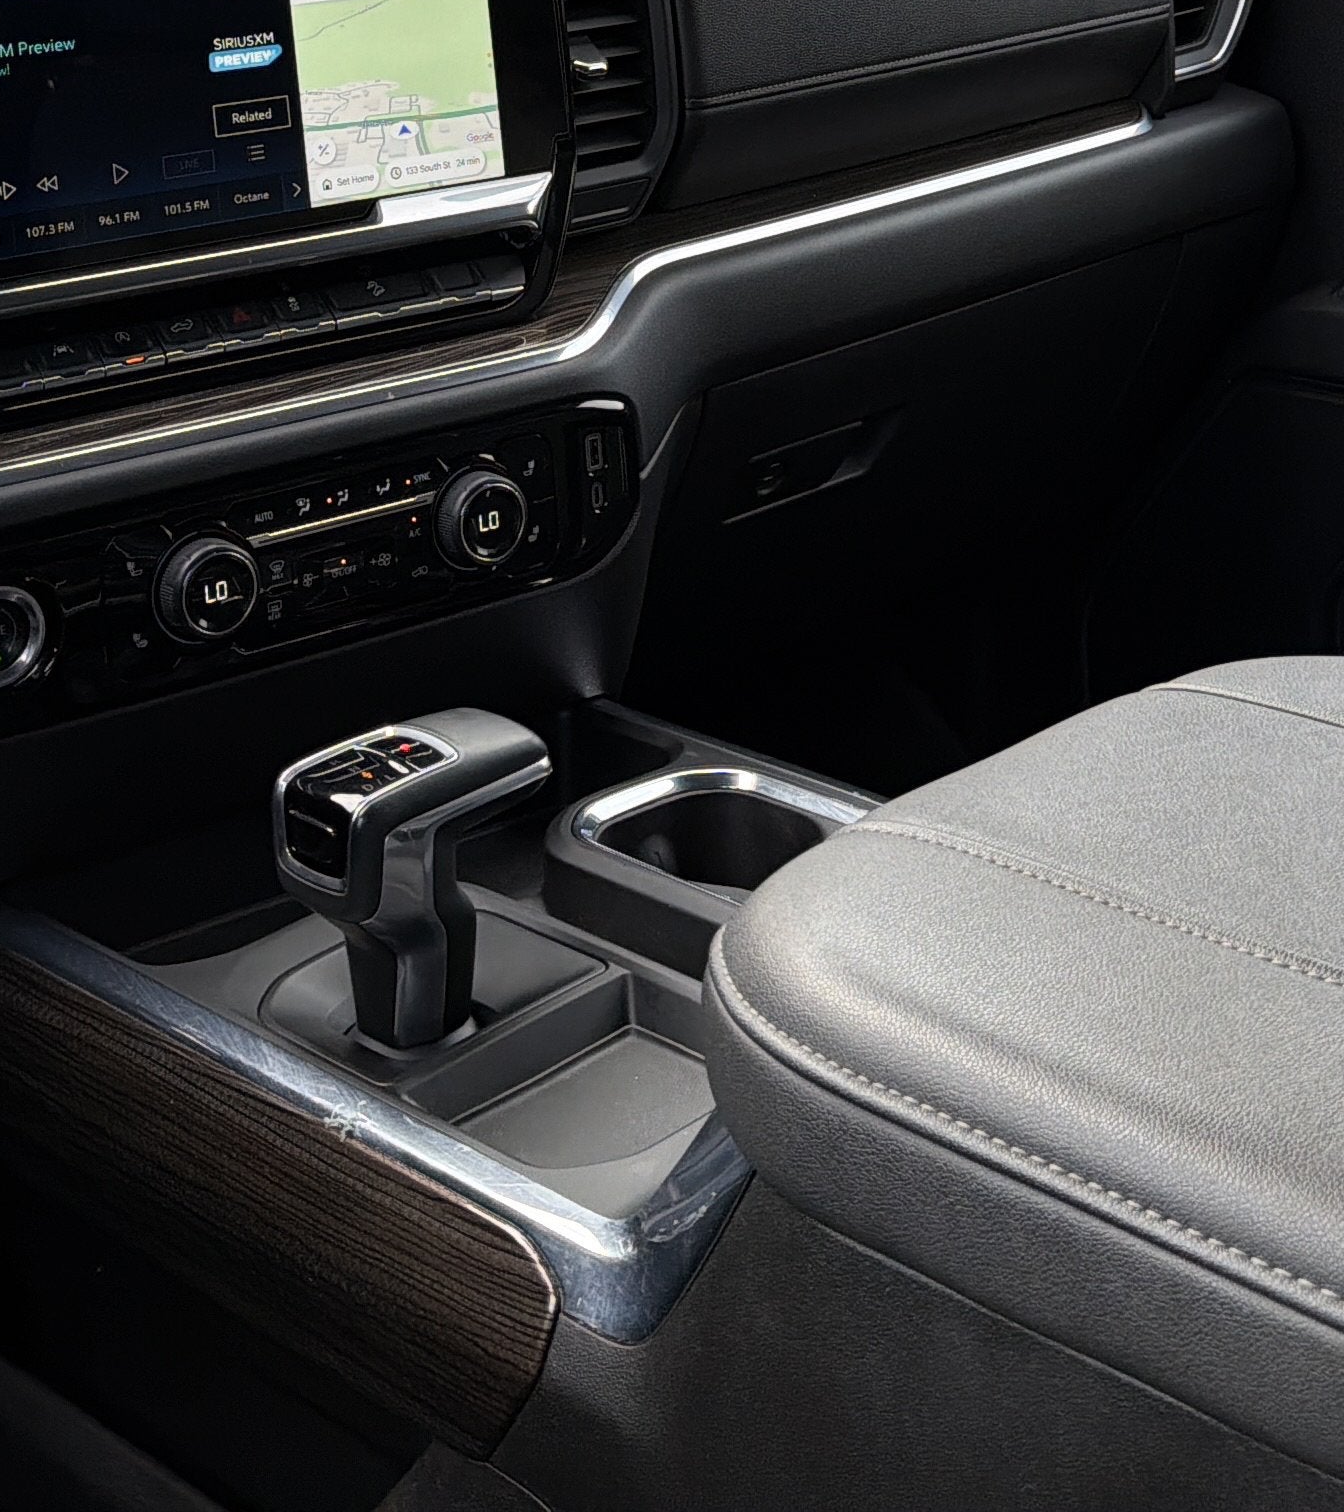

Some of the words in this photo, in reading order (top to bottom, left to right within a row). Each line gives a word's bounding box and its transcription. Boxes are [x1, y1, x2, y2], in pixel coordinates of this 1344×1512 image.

[17, 38, 76, 56] Preview
[213, 31, 275, 50] SIRIUSXM
[214, 48, 276, 68] PREVIEW
[232, 108, 273, 125] Related
[466, 131, 494, 144] Google
[406, 166, 419, 176] 133
[419, 162, 443, 175] South
[443, 160, 452, 170] St
[456, 158, 466, 168] 24
[466, 157, 481, 167] min
[336, 177, 351, 187] Set
[352, 174, 375, 184] Home
[233, 191, 270, 205] Octane
[164, 201, 193, 217] 101.5
[194, 199, 210, 212] FM
[98, 214, 121, 226] 96.1
[123, 211, 141, 223] FM
[25, 223, 56, 239] 107.3
[57, 220, 75, 233] FM
[412, 472, 432, 484] SYNC
[254, 510, 274, 524] AUTO
[478, 510, 500, 533] LO
[204, 580, 228, 604] LO
